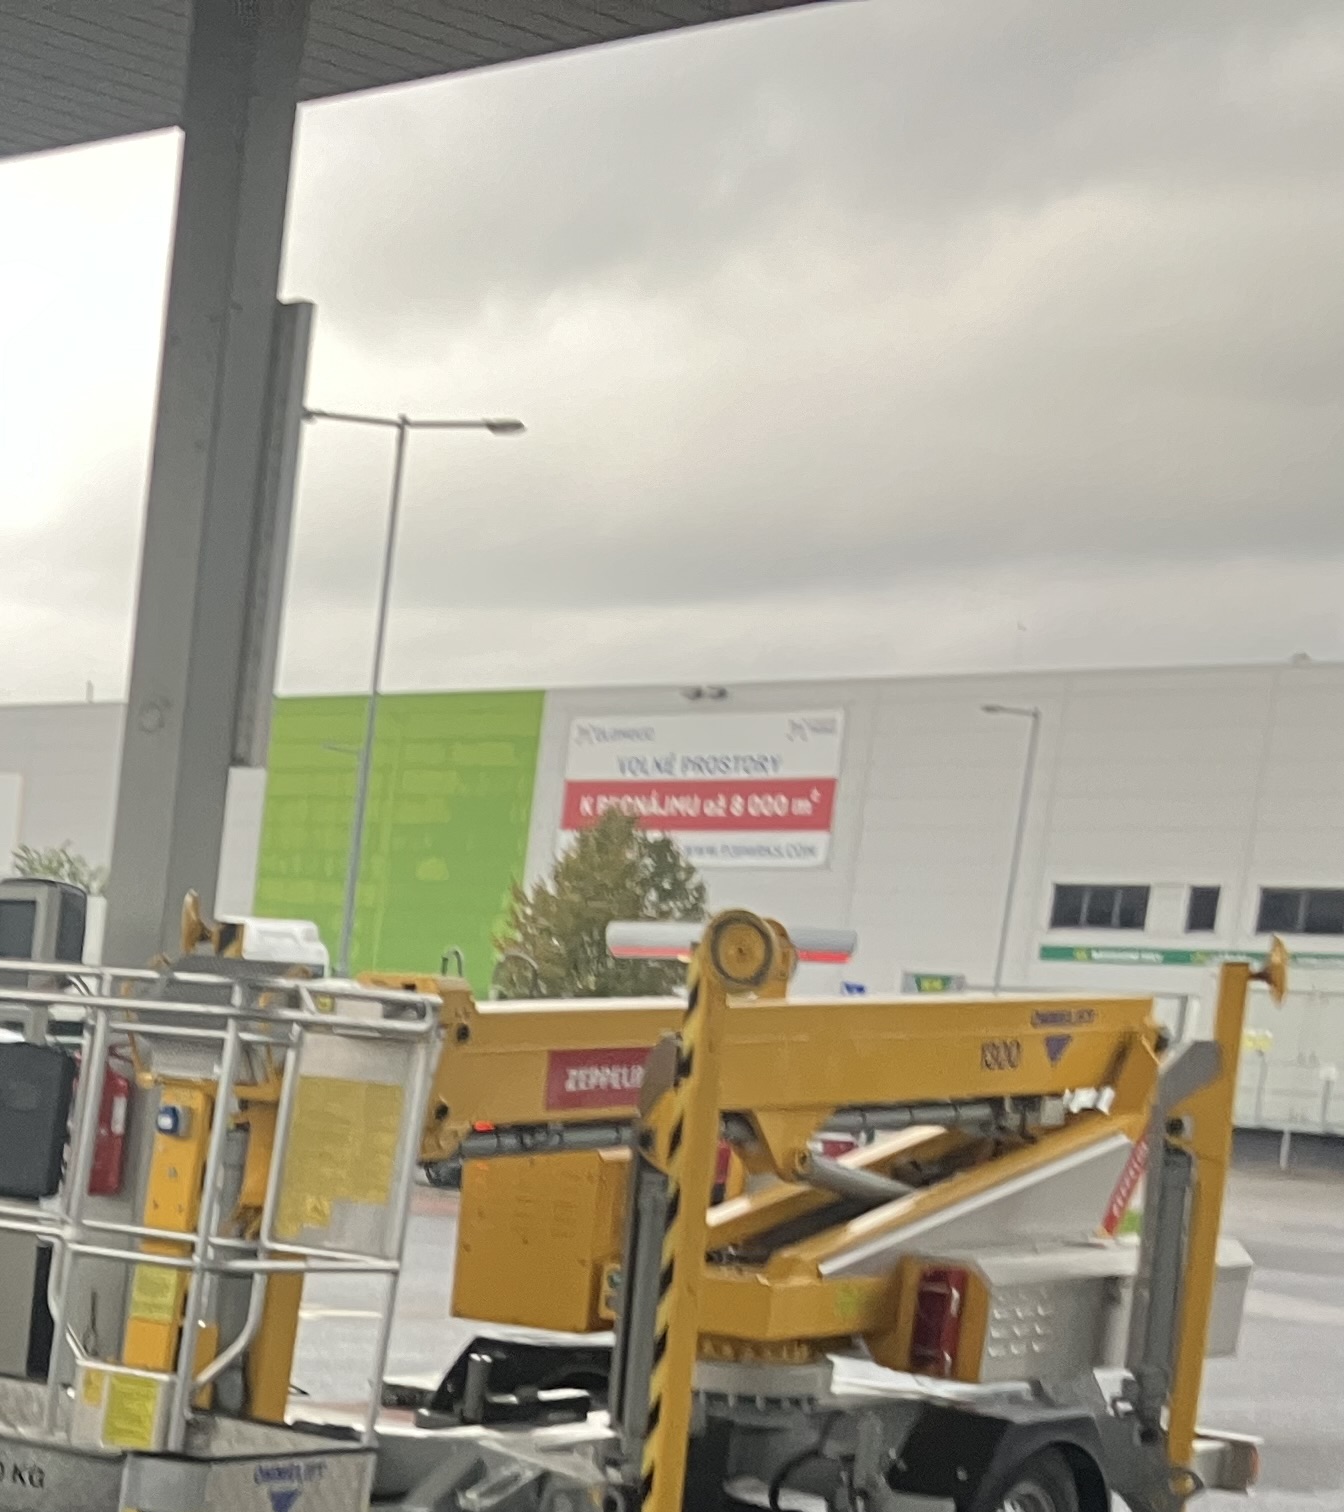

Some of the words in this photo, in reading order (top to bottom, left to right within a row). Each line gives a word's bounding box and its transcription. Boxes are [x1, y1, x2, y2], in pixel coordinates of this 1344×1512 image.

[618, 752, 677, 777] VOLNÉ
[681, 753, 782, 776] PROSTORY
[578, 794, 594, 817] K
[703, 791, 727, 817] až
[729, 794, 745, 817] 8
[747, 793, 789, 817] 000
[12, 1461, 47, 1489] KG
